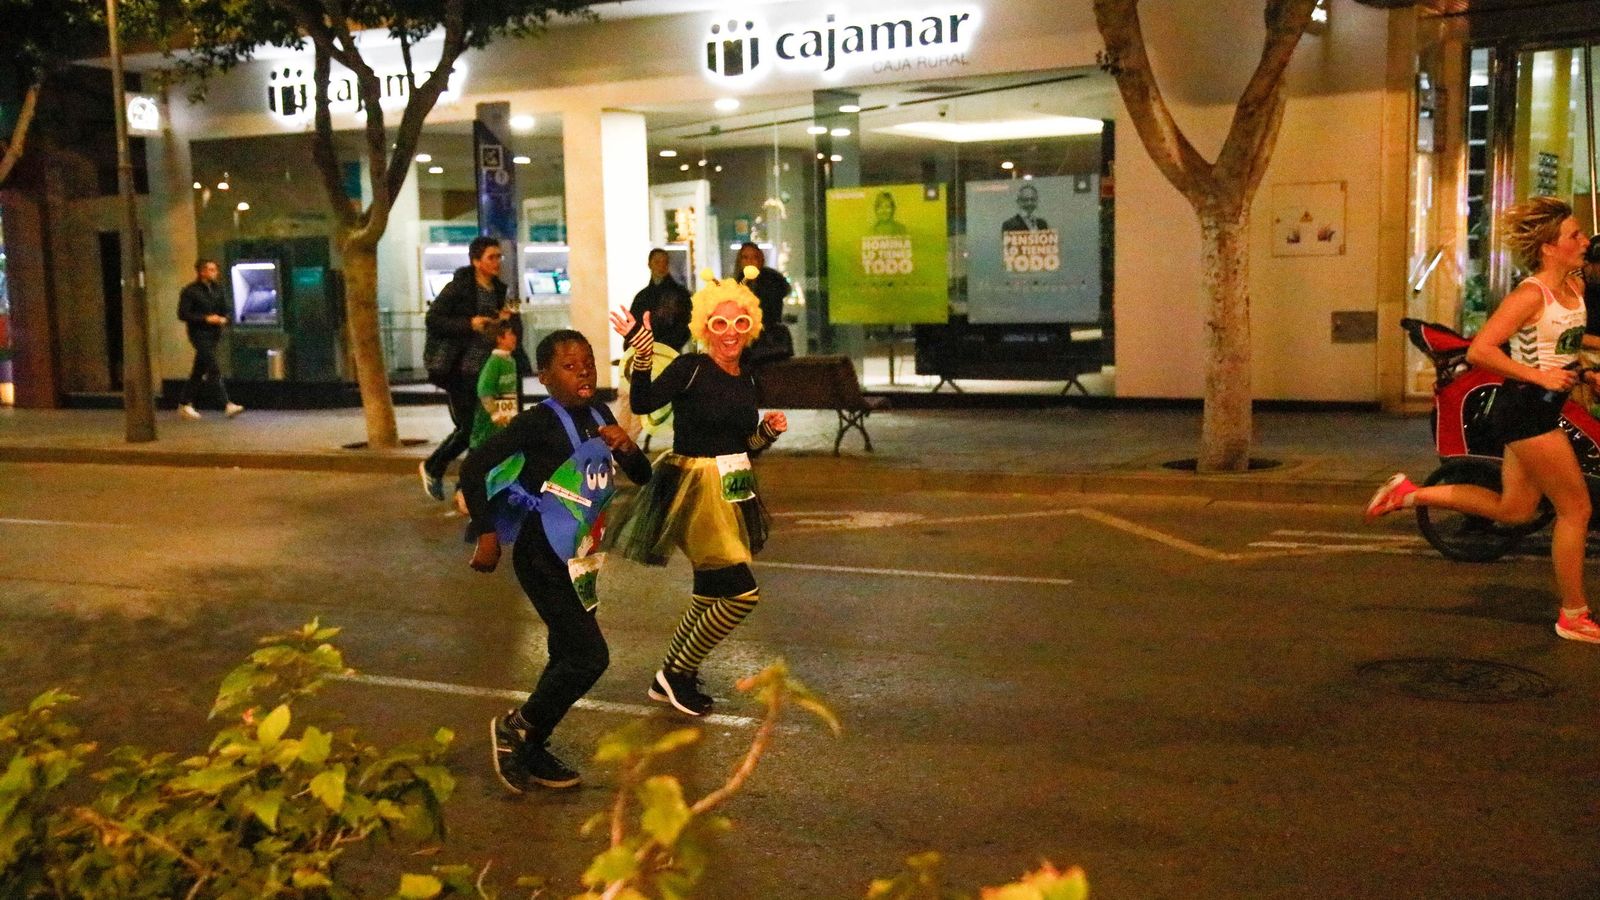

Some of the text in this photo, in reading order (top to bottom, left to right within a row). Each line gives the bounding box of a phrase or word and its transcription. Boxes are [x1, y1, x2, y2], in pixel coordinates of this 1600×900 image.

[775, 13, 970, 71] cajamar
[872, 53, 969, 74] CAJA RURAL
[862, 258, 913, 274] TODO
[1003, 255, 1060, 272] TODO
